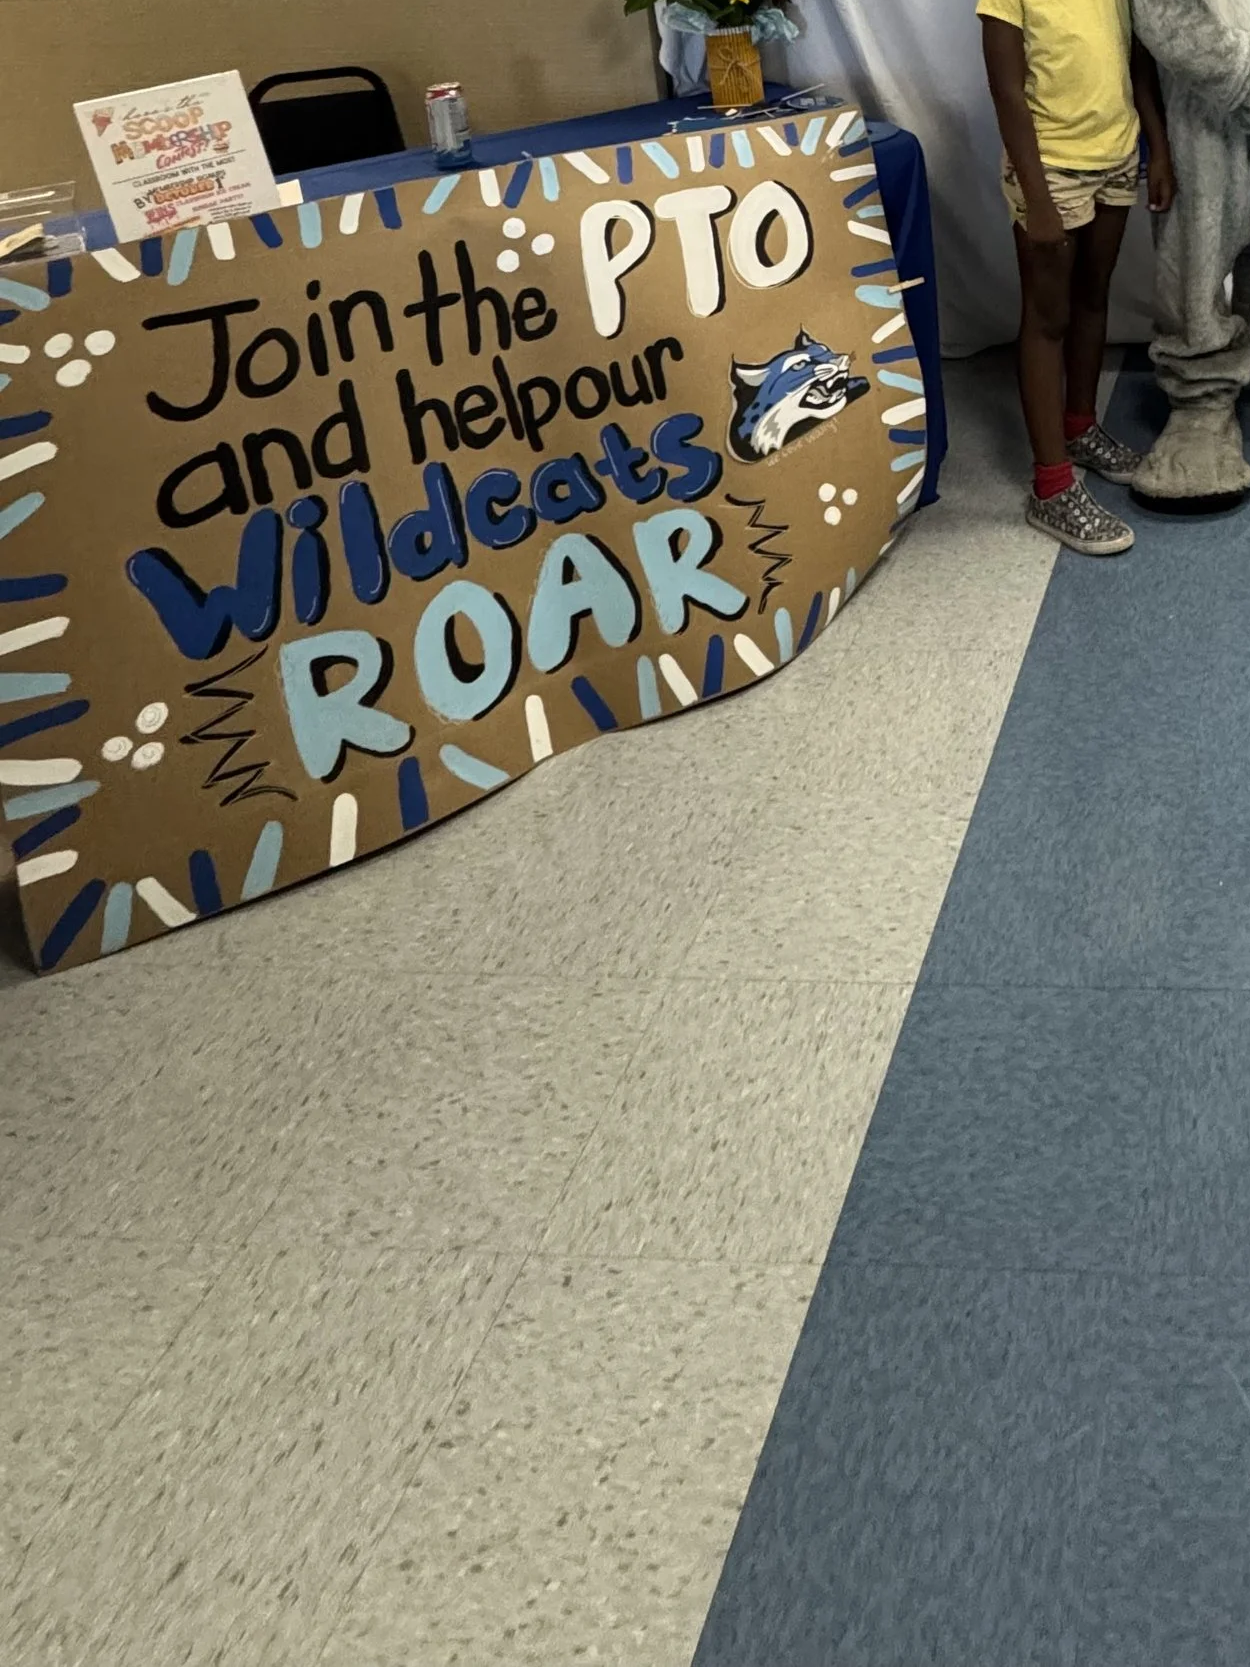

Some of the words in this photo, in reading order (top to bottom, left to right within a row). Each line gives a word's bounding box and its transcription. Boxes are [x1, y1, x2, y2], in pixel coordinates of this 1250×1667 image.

[122, 106, 204, 140] SCOOP
[181, 165, 200, 176] WITH
[200, 160, 215, 171] THE
[133, 194, 152, 210] BY
[141, 278, 397, 423] Join
[403, 239, 558, 364] the
[578, 180, 816, 339] PTO
[156, 379, 372, 531] and
[125, 412, 725, 662] Wildcats
[276, 507, 751, 784] ROAR
